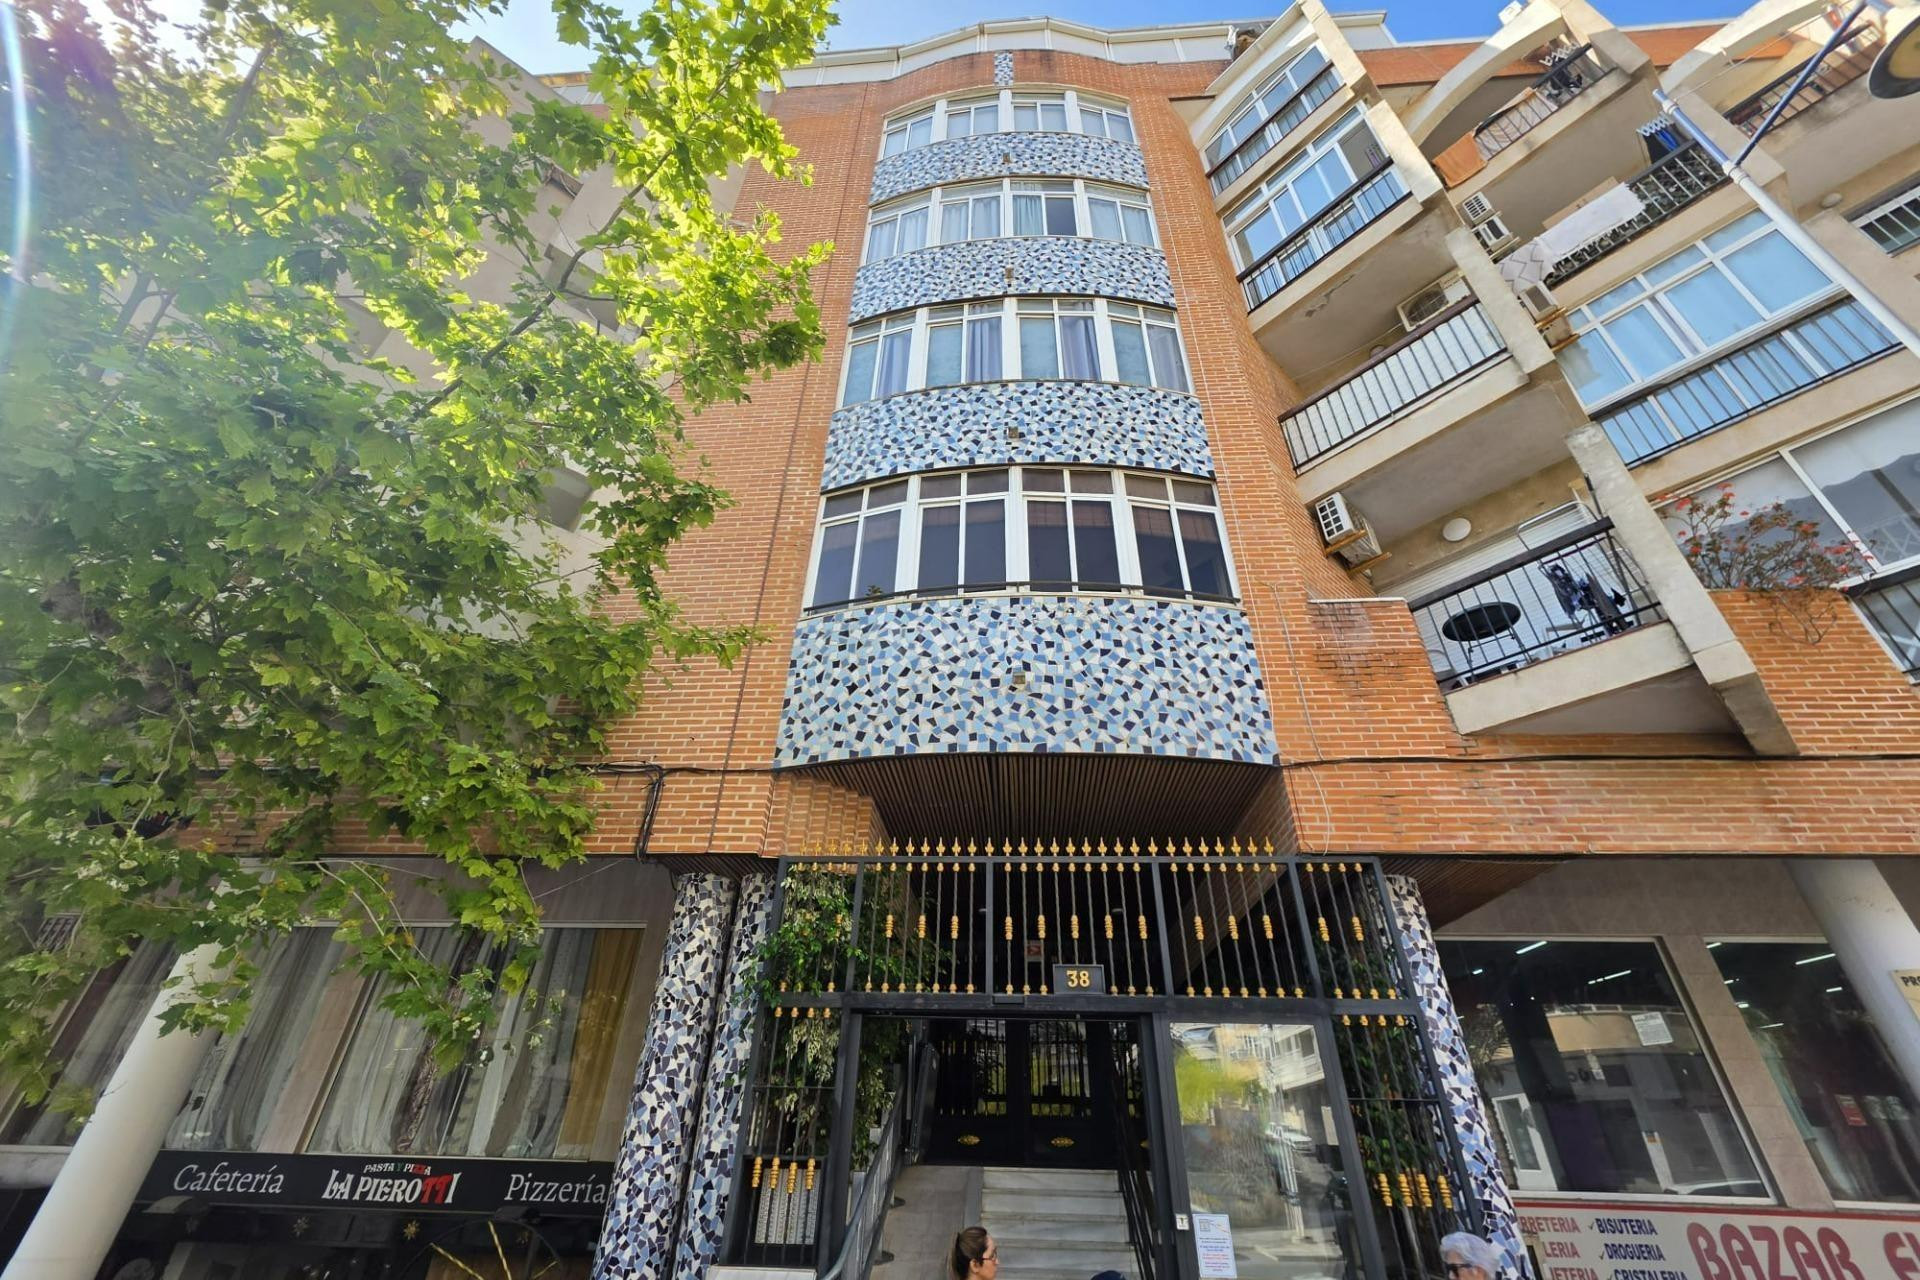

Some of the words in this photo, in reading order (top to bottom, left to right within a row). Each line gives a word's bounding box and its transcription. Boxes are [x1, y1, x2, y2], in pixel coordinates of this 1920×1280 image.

[1066, 970, 1090, 988] 38
[173, 1161, 285, 1194] Cafetería
[363, 1162, 395, 1174] PASTA
[403, 1163, 432, 1176] PIZZA
[321, 1169, 355, 1200] LA
[352, 1171, 462, 1205] PIEROTTI
[504, 1172, 606, 1204] Pizzería
[1517, 1215, 1581, 1233] RRETERIA
[1595, 1217, 1658, 1236] BISUTERIA
[1604, 1243, 1667, 1261] DROGUERIA
[1686, 1222, 1866, 1280] BAZAR
